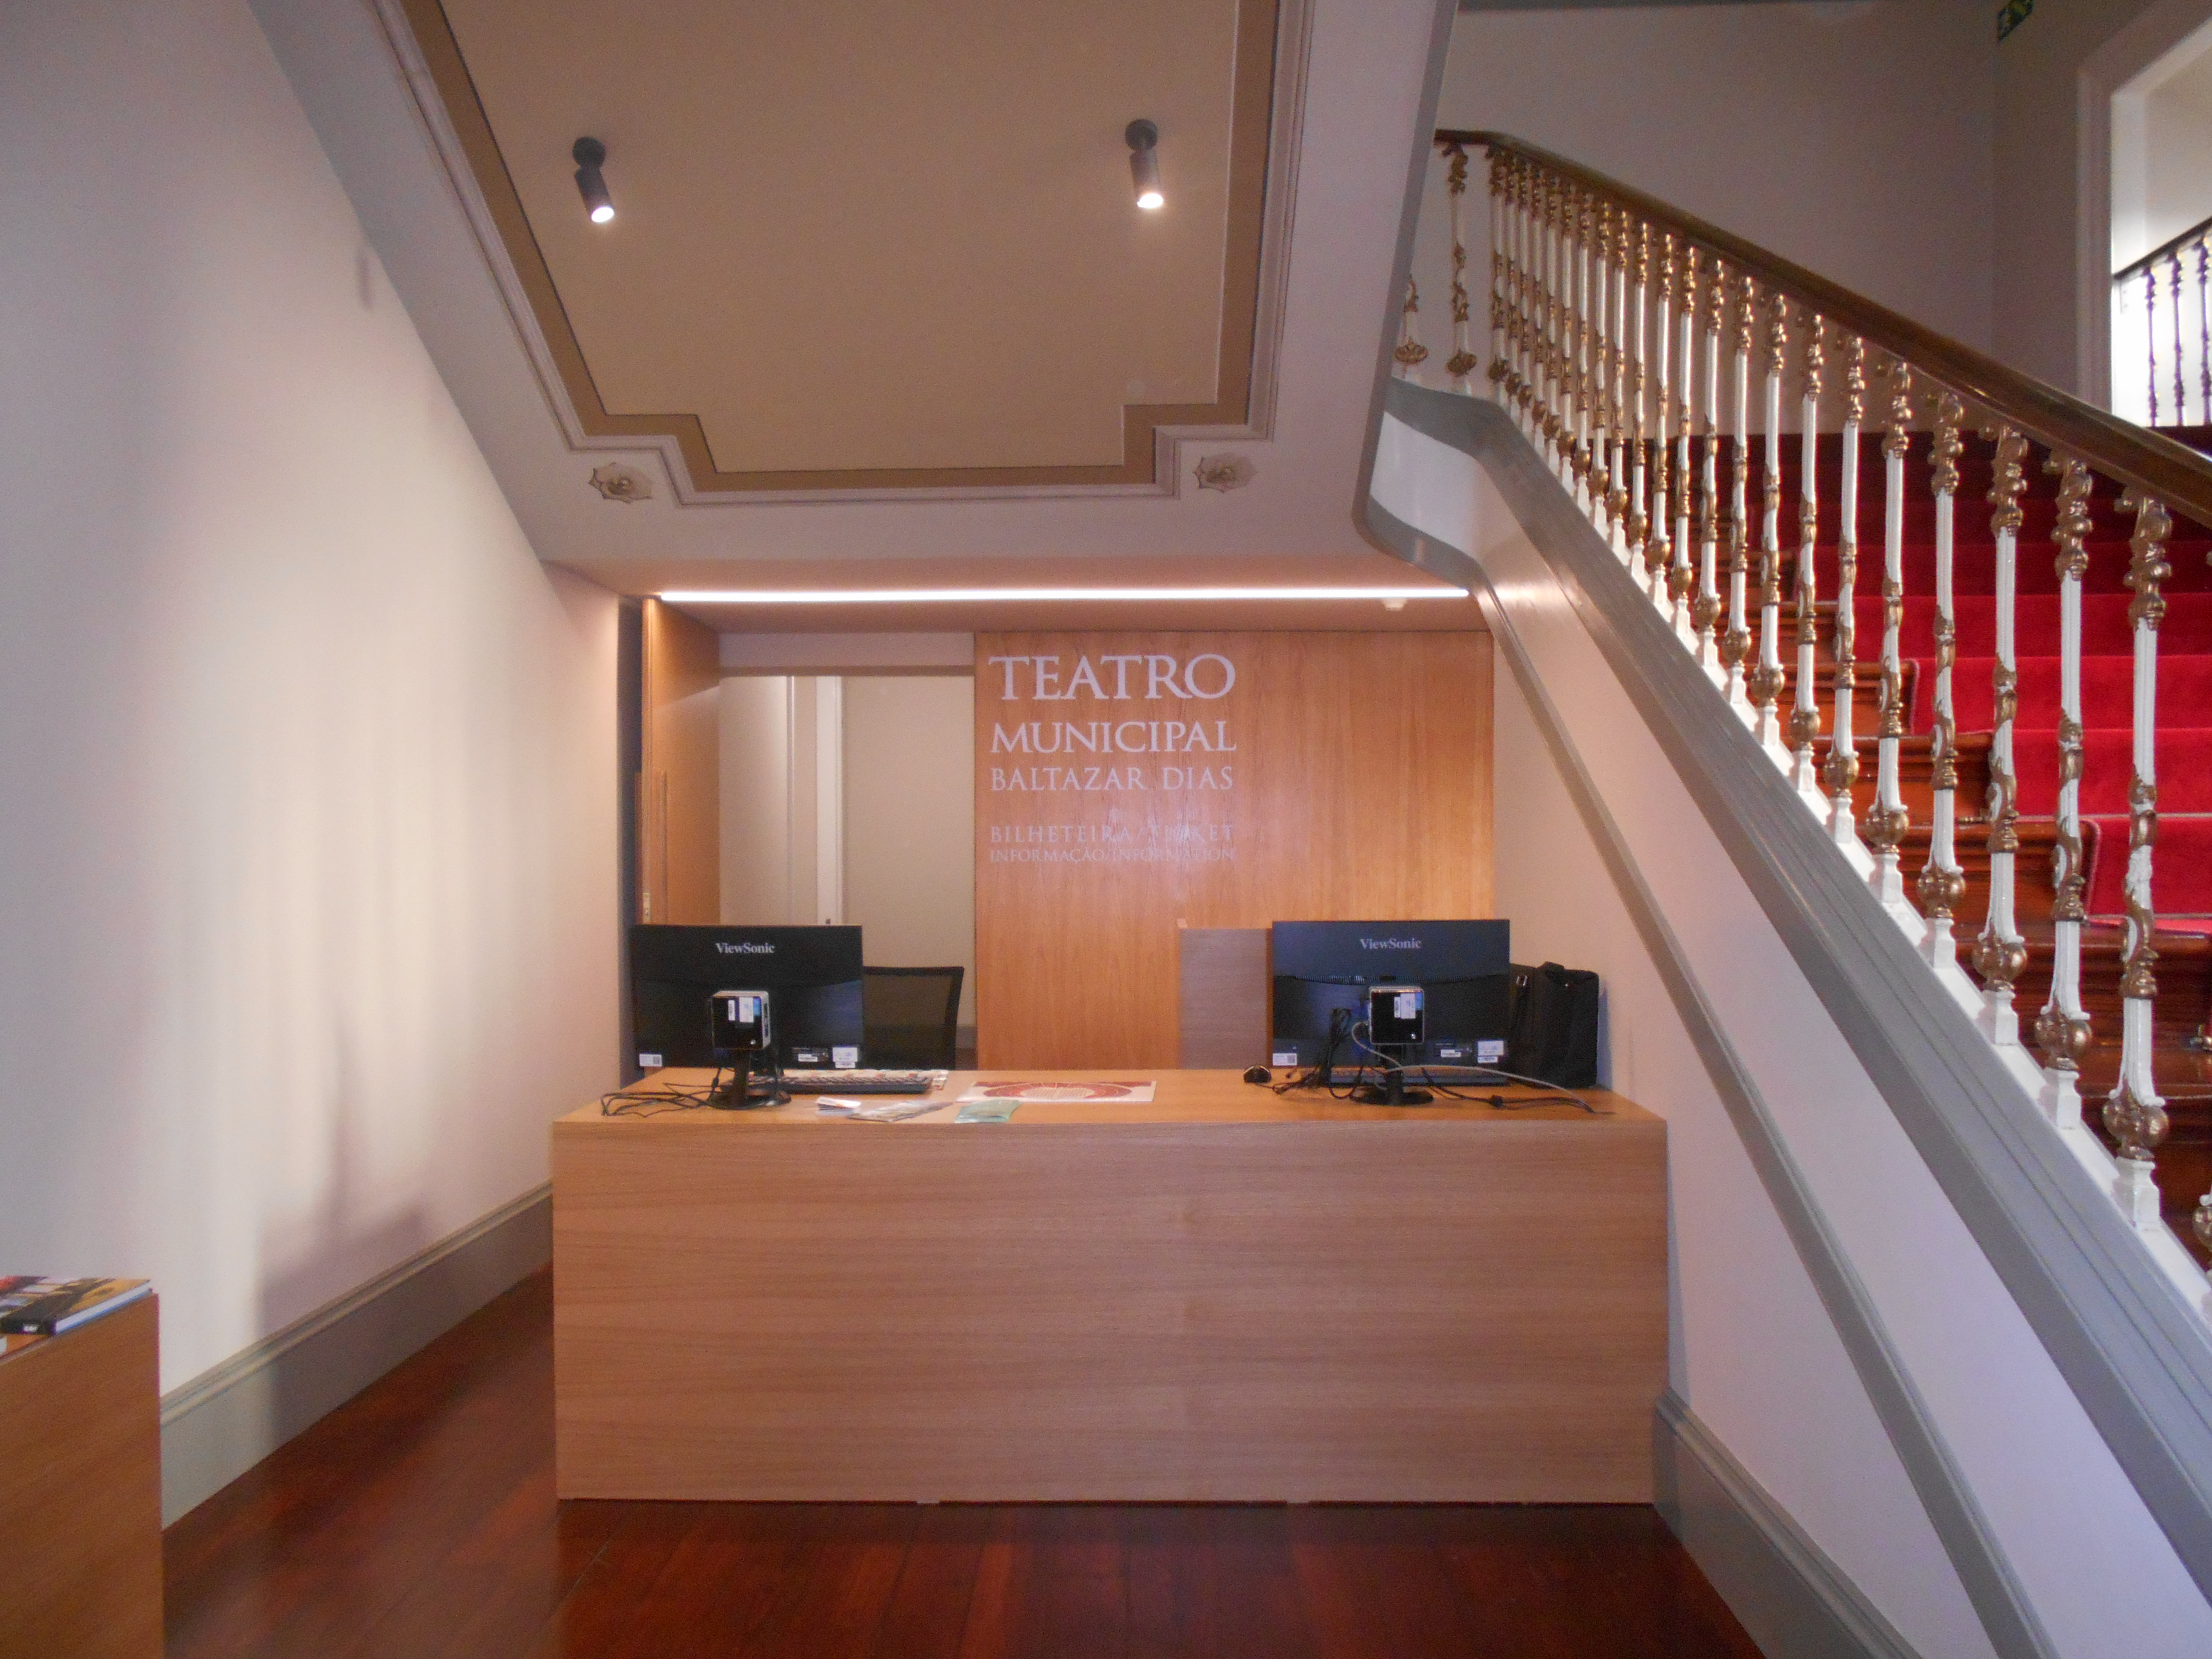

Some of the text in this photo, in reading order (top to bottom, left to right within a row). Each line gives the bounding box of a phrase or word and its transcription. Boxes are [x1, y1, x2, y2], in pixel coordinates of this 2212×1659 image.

[988, 653, 1236, 700] TEATRO
[990, 721, 1237, 754] MUNICIPAL
[991, 766, 1233, 791] BALTAZAR DIAS
[715, 942, 775, 954] ViewSonic
[1359, 937, 1422, 949] ViewSonic
